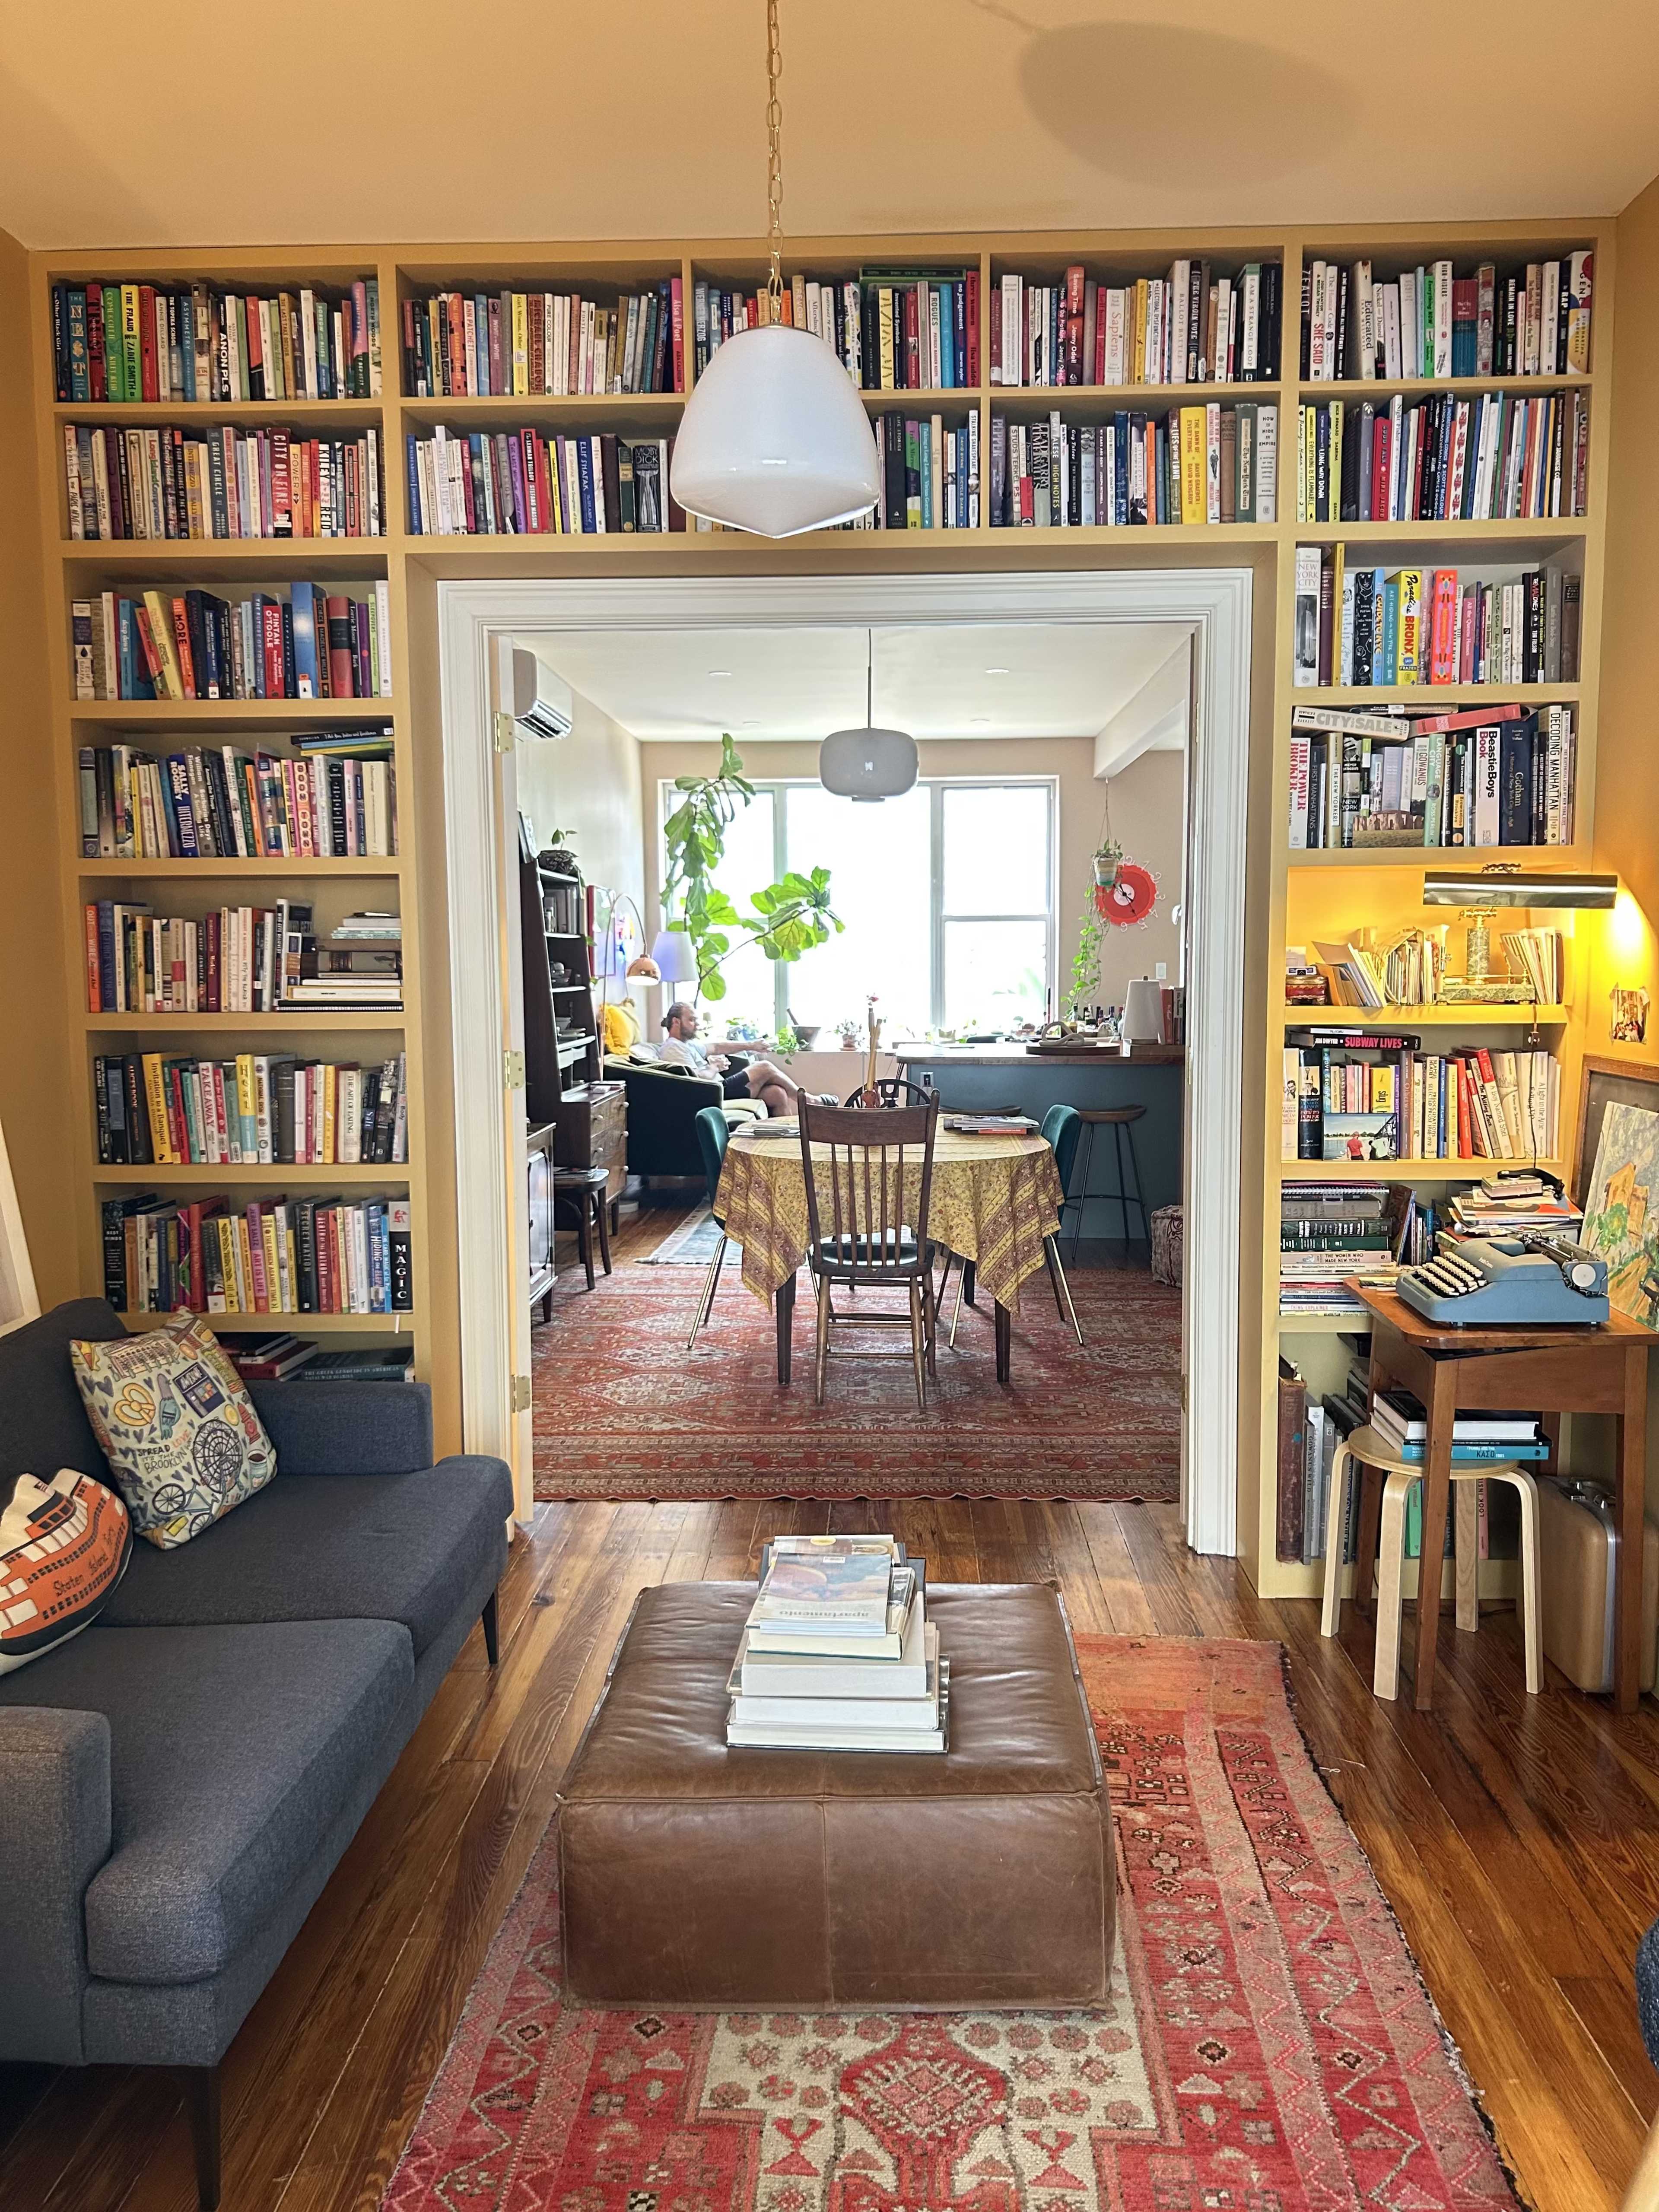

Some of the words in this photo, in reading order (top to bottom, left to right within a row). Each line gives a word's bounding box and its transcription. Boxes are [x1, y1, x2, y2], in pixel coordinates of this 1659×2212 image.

[958, 283, 962, 292] no
[1249, 284, 1255, 295] AM
[1301, 270, 1310, 314] ZEALOT
[673, 299, 682, 315] Also
[465, 318, 475, 352] PATCHETT
[674, 325, 682, 341] Poet
[1109, 312, 1122, 357] Sapiens
[1313, 324, 1324, 341] SHE
[1365, 300, 1374, 350] Educated
[127, 341, 135, 362] ZADIE
[219, 332, 228, 367] ANON
[1313, 343, 1323, 364] SAID
[128, 365, 137, 390] SMITH
[212, 442, 220, 466] GREAT
[273, 435, 286, 459] CITY
[635, 446, 658, 455] MOBY
[635, 455, 658, 464] DICK
[274, 464, 287, 480] ON
[319, 450, 330, 479] KILEY
[213, 470, 222, 495] CIRCLE
[275, 481, 288, 504] FIRE
[321, 507, 331, 530] REID
[1405, 575, 1418, 614] Paradise
[175, 614, 187, 645] MORE
[272, 613, 280, 645] FINTAN
[1405, 616, 1414, 655] BRONX
[1316, 713, 1350, 728] CITY
[1355, 715, 1392, 733] SALE
[1551, 713, 1560, 756] DECODING
[1299, 740, 1308, 763] THE
[1479, 731, 1488, 759] Book
[1289, 743, 1299, 791] BROKER
[1417, 752, 1427, 786] GOWANUS
[1486, 731, 1497, 798] BeastieBoys
[170, 761, 183, 801] ROONEY
[178, 764, 190, 795] SALLY
[1298, 766, 1307, 810] POWER
[1515, 772, 1525, 806] Gotham
[1549, 759, 1560, 810] MANHATTAN
[177, 806, 196, 848] INTERMEZZO
[1345, 1037, 1378, 1047] SUBWAY
[1380, 1039, 1402, 1049] LIVES
[152, 1062, 161, 1098] Invitation
[158, 1114, 167, 1145] Banquet
[201, 1066, 215, 1128] TAKEAWAY
[1376, 1091, 1388, 1103] slug
[301, 1211, 310, 1243] SECRET
[302, 1244, 311, 1272] NATION
[395, 1245, 407, 1299] MAGIC
[138, 1444, 171, 1457] SPREAD
[53, 1573, 84, 1597] Staten
